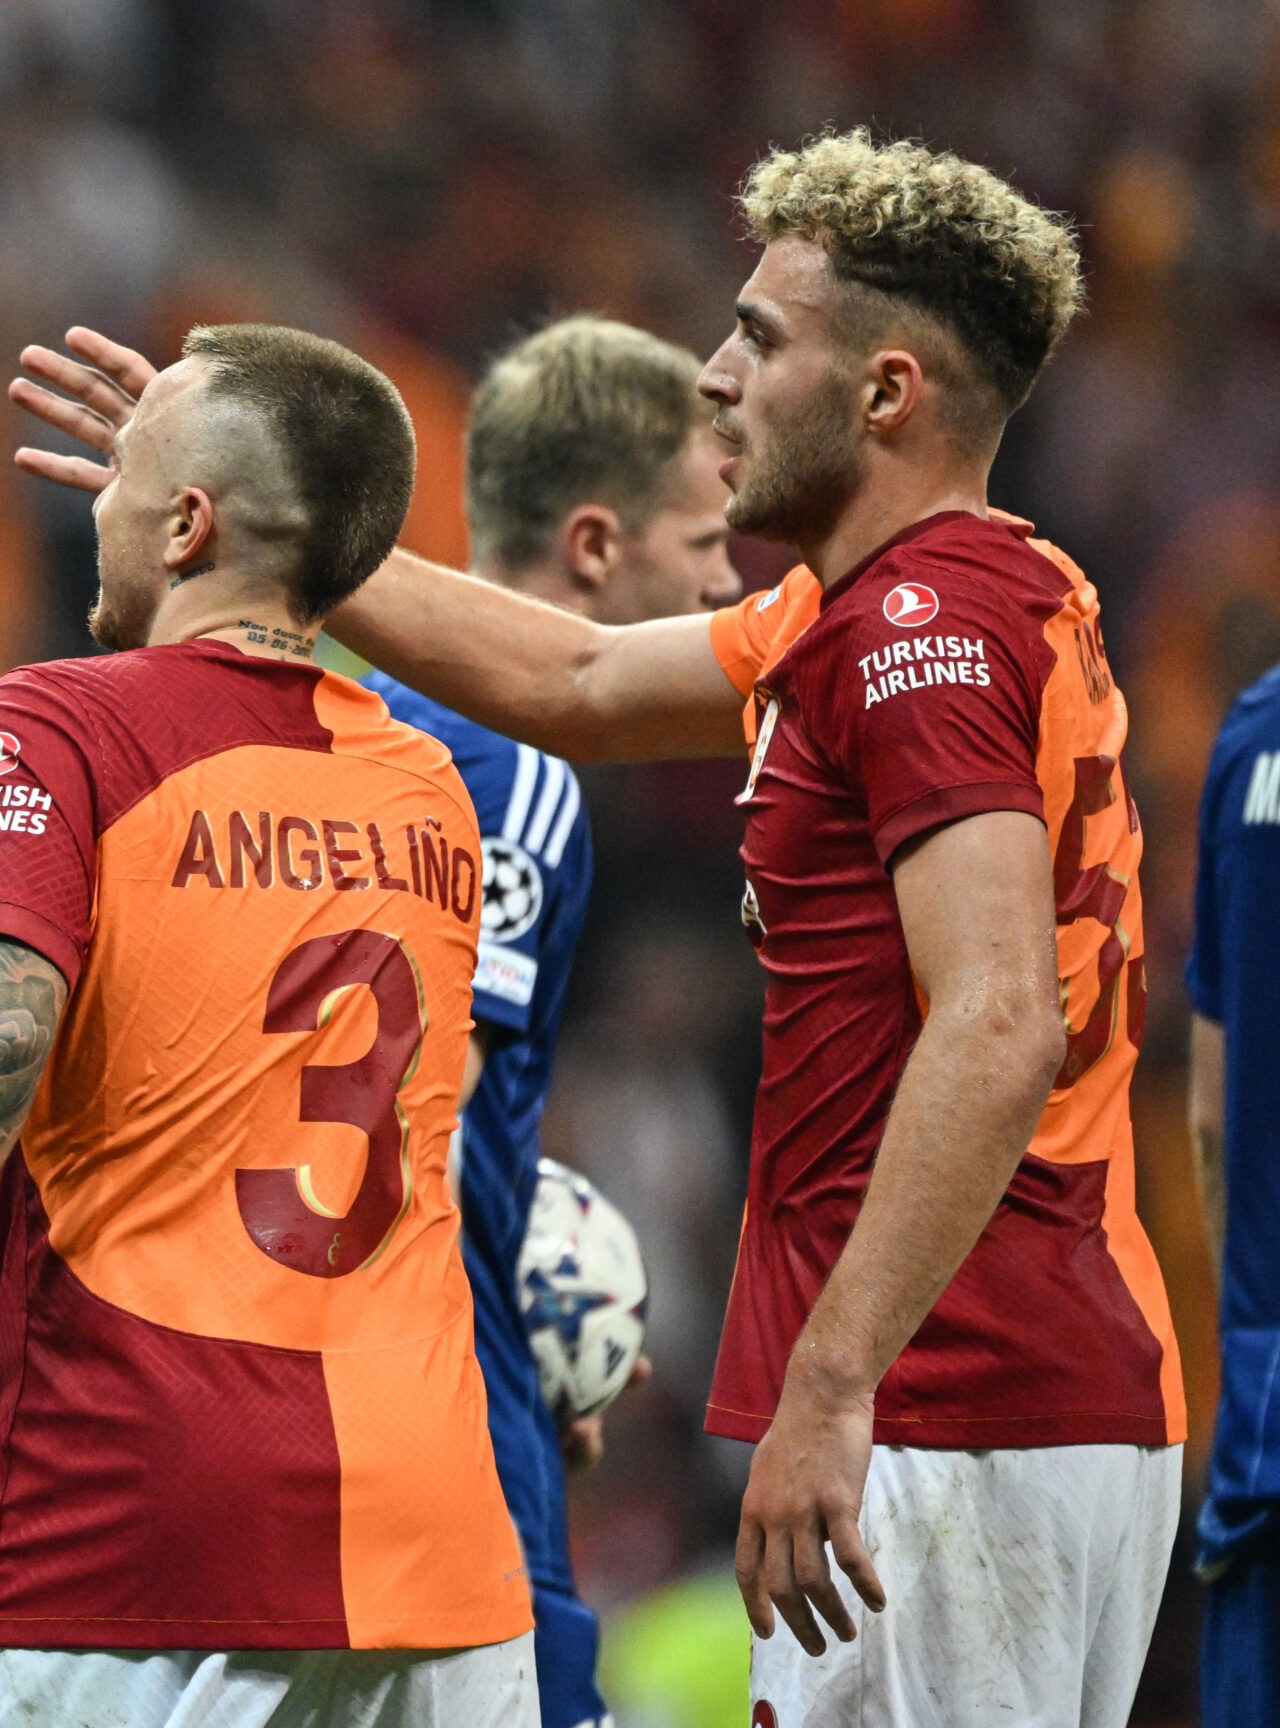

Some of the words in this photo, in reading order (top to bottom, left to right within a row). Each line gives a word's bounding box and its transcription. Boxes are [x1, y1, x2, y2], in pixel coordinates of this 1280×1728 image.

[858, 635, 985, 681] TURKISH
[865, 661, 991, 710] AIRLINES
[171, 809, 477, 924] ANGELIÑO
[234, 928, 429, 1279] 3
